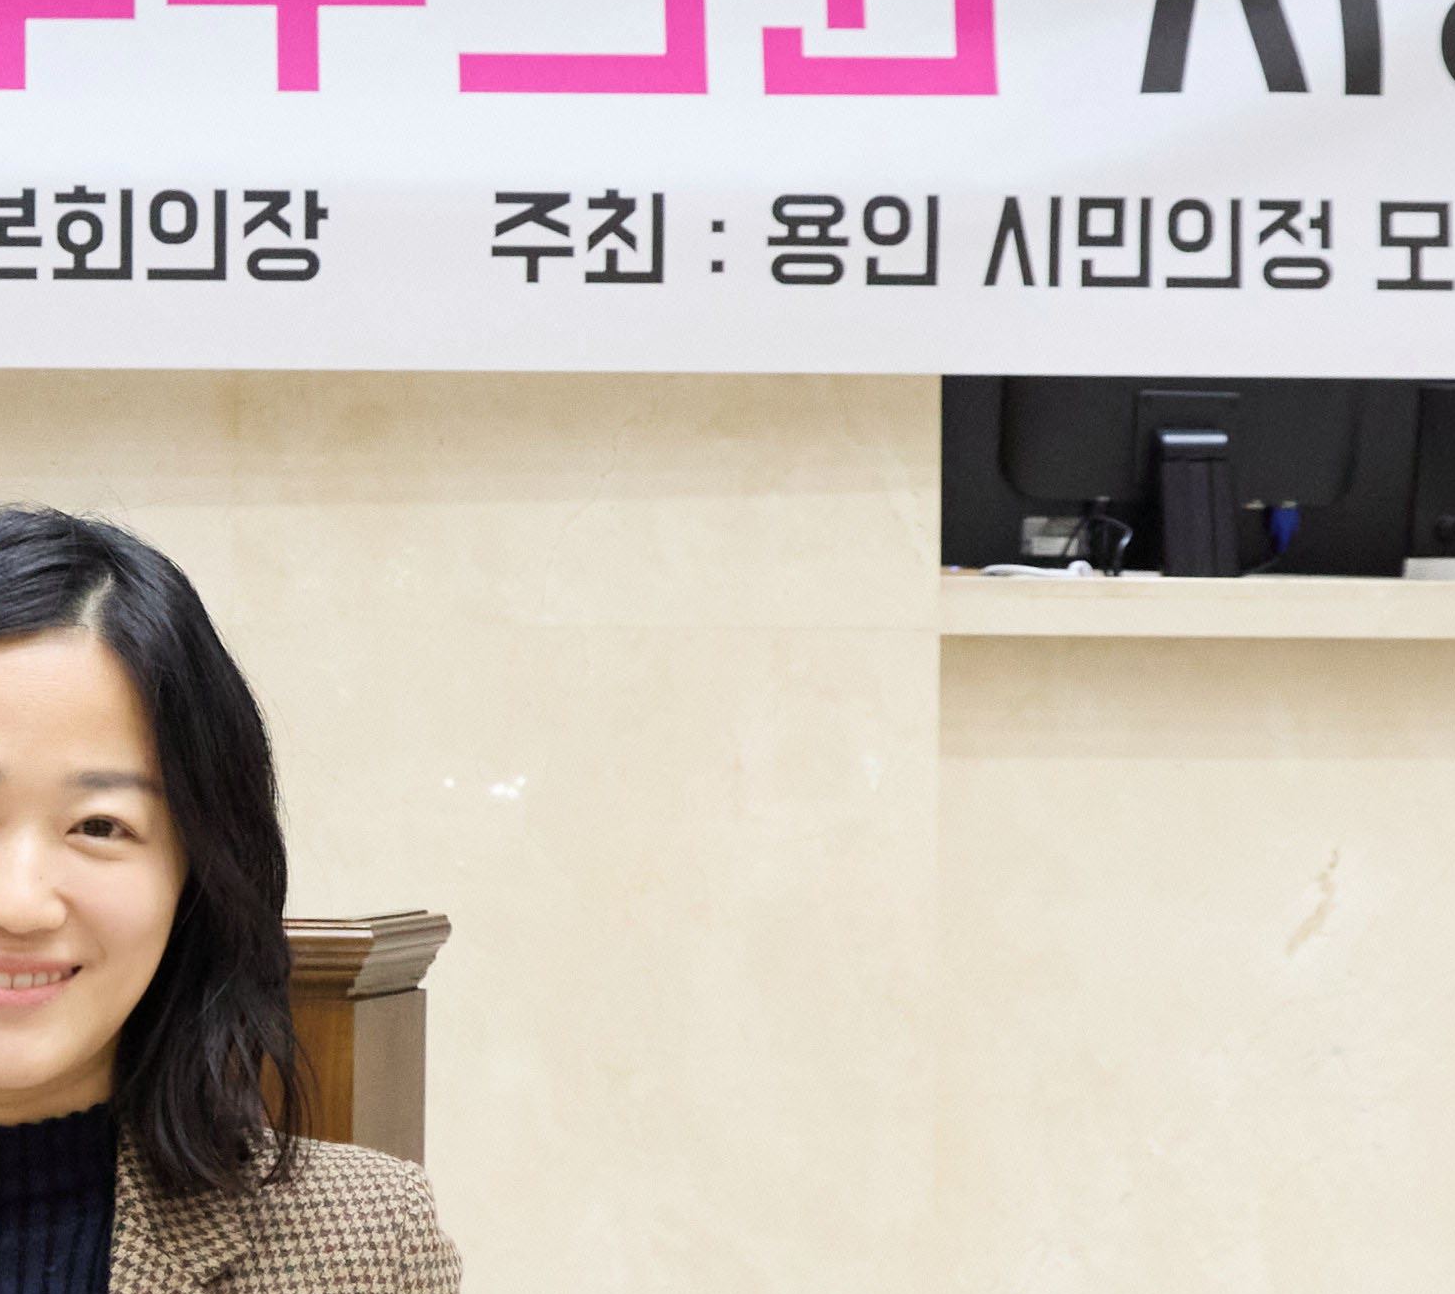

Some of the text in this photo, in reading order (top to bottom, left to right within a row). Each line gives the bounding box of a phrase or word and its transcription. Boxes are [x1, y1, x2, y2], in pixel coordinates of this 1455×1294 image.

[491, 189, 665, 284] 주최
[767, 194, 939, 287] 용인
[983, 196, 1332, 290] 시민의정
